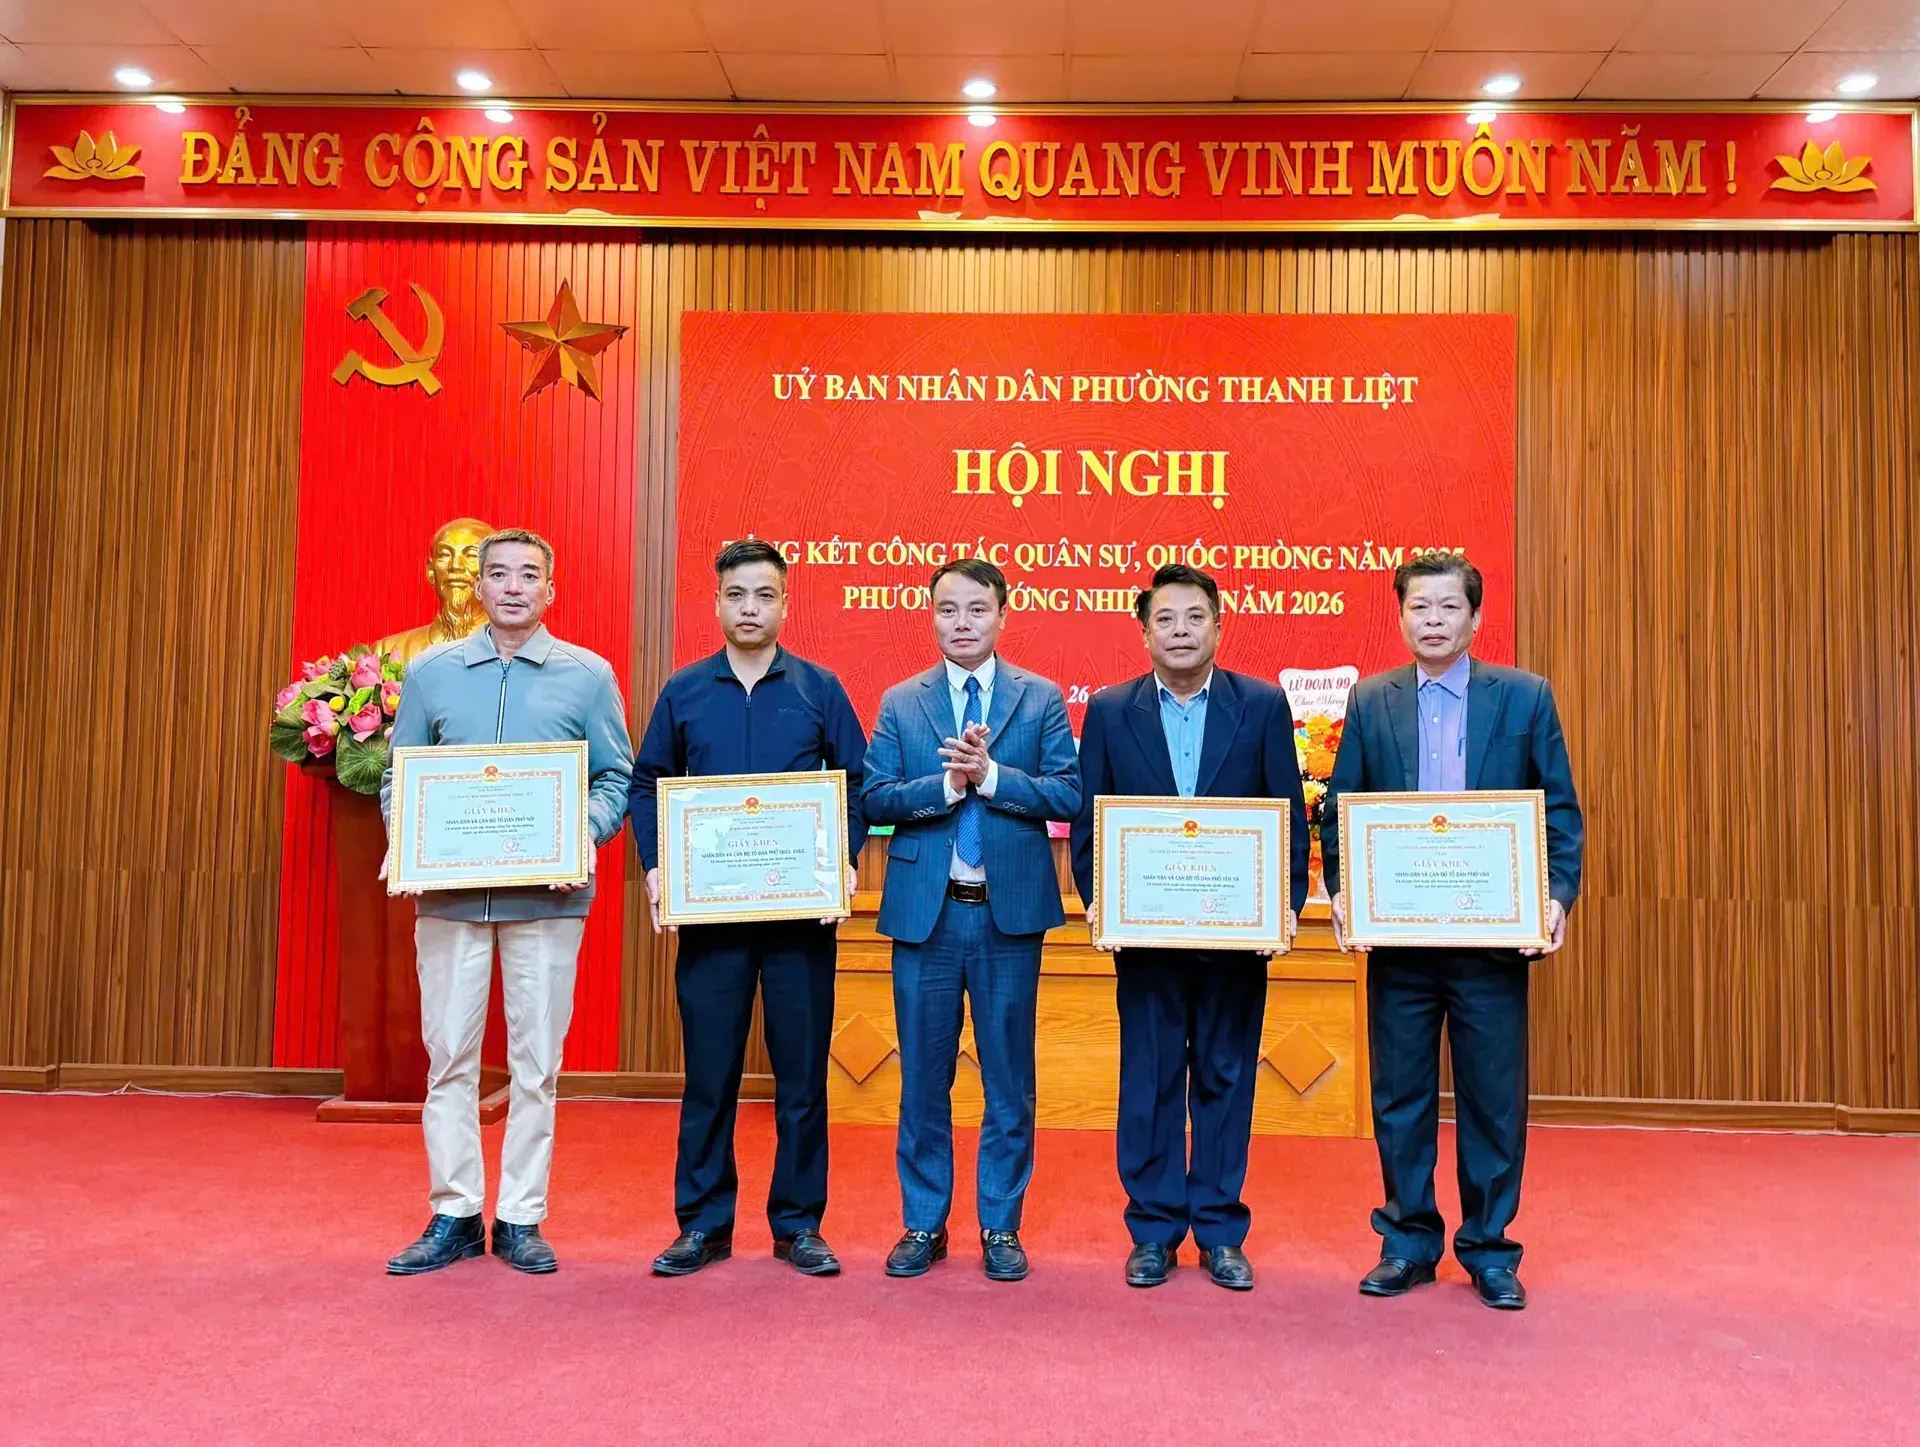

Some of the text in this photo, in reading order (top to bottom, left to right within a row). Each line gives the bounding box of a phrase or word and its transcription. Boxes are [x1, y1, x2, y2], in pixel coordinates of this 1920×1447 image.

[178, 106, 344, 188] ĐẢNG
[366, 116, 527, 206] CỘNG
[545, 111, 663, 195] SẢN
[680, 123, 817, 211] VIỆT
[832, 141, 965, 198] NAM
[978, 140, 1186, 202] QUANG
[1207, 140, 1354, 198] VINH
[1367, 121, 1549, 198] MUÔN
[1566, 123, 1708, 196] NĂM
[772, 367, 1419, 409] UỶ BAN NHÂN DÂN PHƯỜNG THANH LIỆT
[952, 441, 1230, 510] HỘI NGHỊ
[806, 534, 862, 565] KẾT
[867, 535, 947, 567] CÔNG
[953, 536, 1009, 567] TÁC
[1014, 537, 1092, 572] QUÂN
[1098, 541, 1141, 574] SỰ,
[1147, 538, 1227, 570] QUỐC
[1234, 538, 1333, 571] PHÒNG
[1338, 540, 1405, 571] NĂM
[1075, 586, 1139, 619] NHIỆ
[1220, 585, 1284, 614] NĂM
[1289, 590, 1345, 616] 2026
[1066, 684, 1090, 704] 26
[1336, 677, 1351, 689] 99
